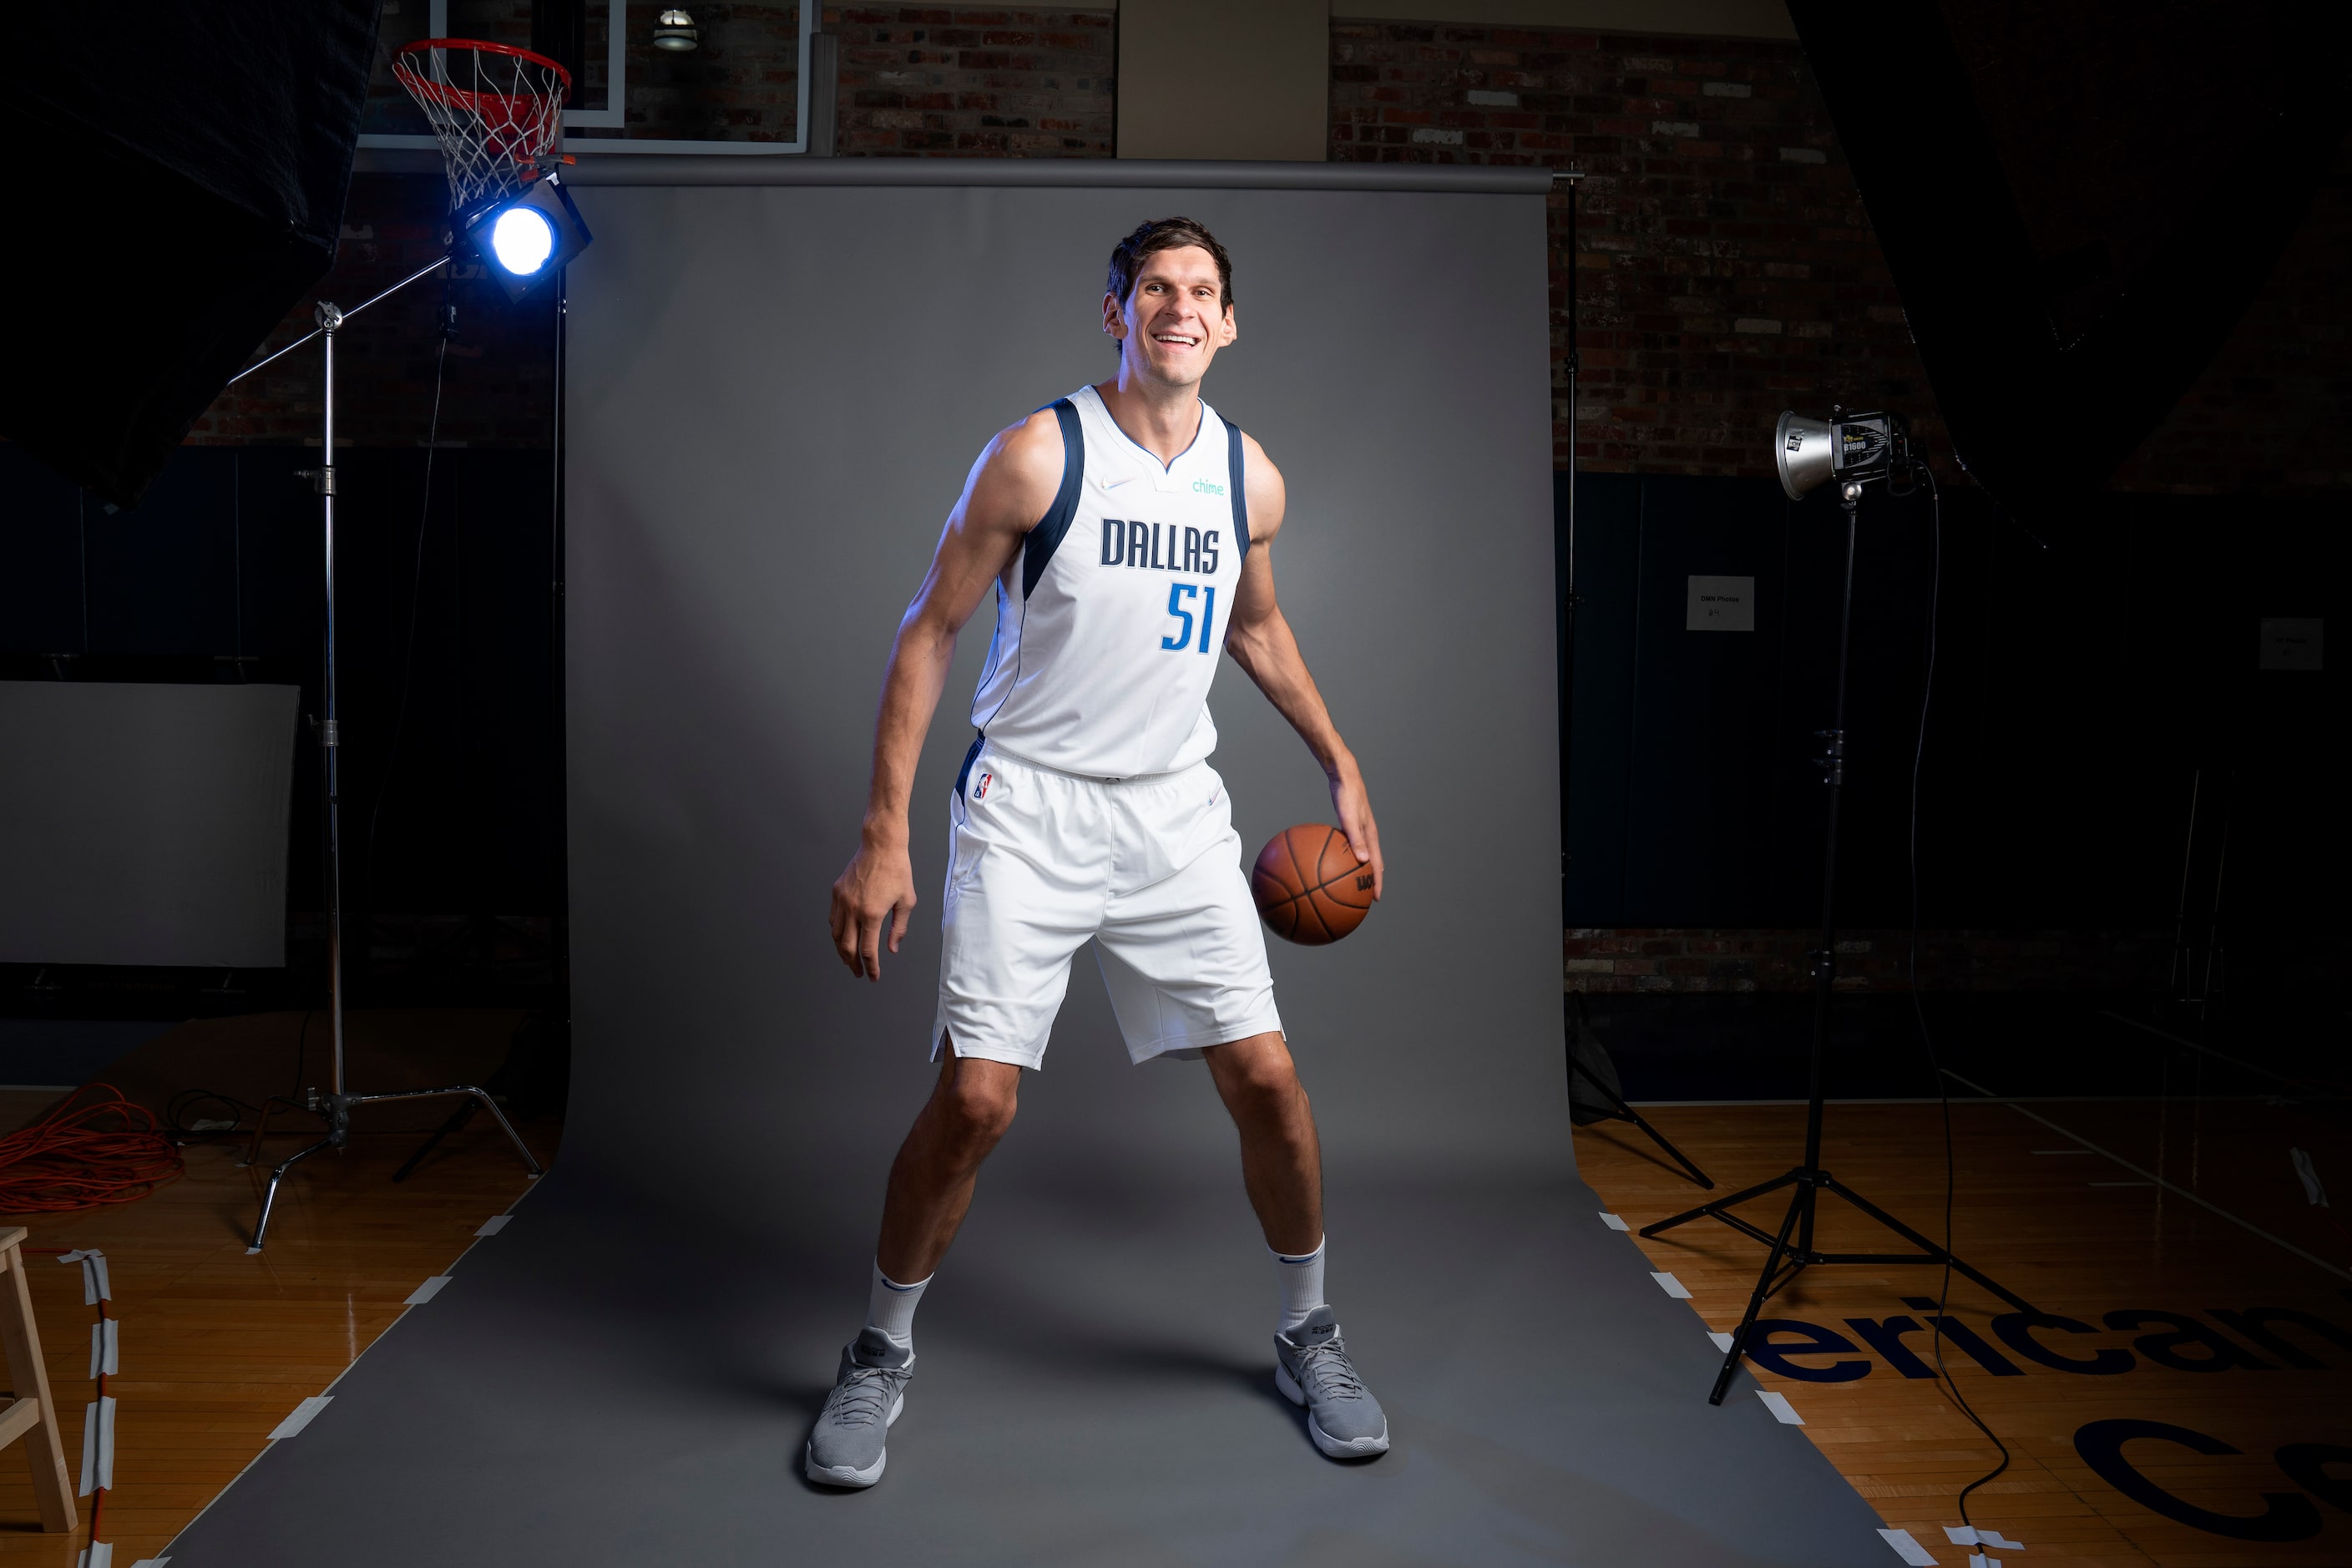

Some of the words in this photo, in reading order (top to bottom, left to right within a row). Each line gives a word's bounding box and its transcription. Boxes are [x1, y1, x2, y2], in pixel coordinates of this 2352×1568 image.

[1844, 441, 1866, 452] B1600
[1192, 478, 1225, 496] chime
[1099, 518, 1220, 576] DALLAS
[1160, 582, 1216, 655] 51
